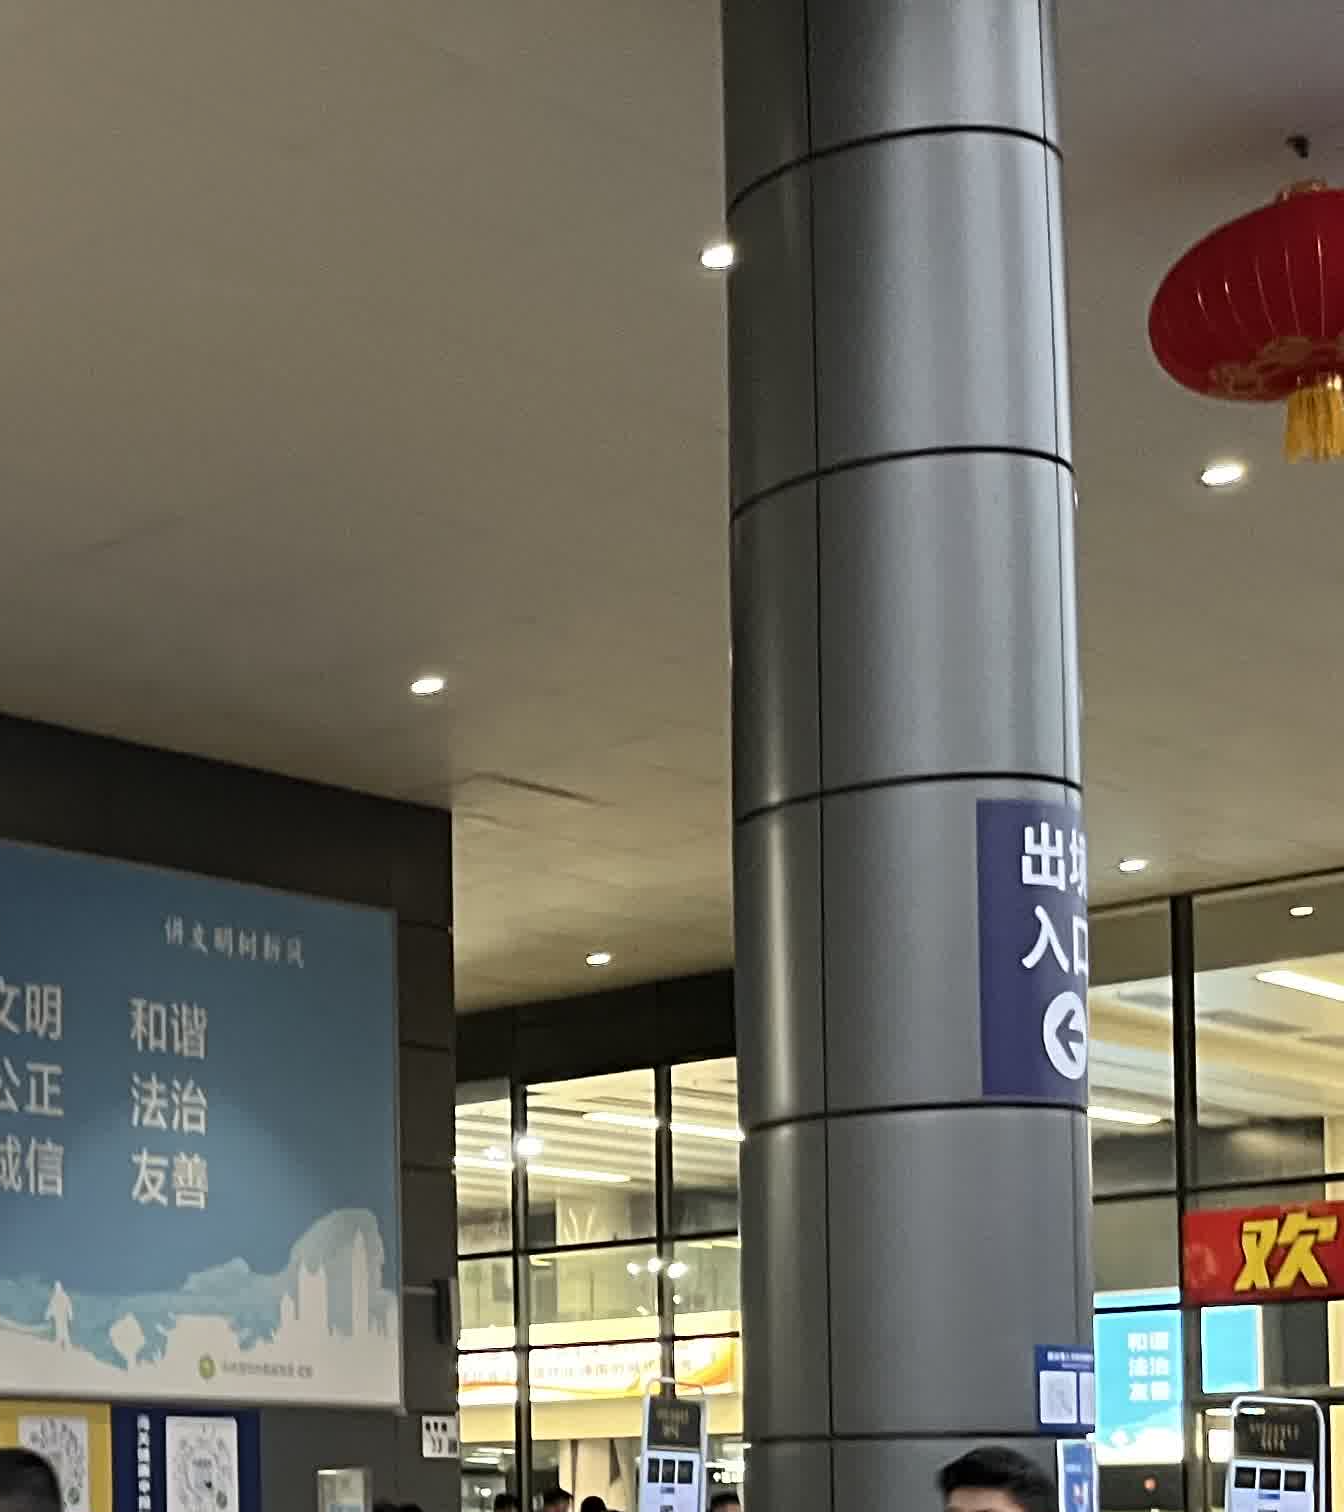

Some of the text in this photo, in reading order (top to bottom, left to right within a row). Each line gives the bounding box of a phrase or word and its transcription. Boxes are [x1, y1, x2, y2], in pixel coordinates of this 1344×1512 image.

[129, 998, 209, 1060] 和谐
[130, 1073, 209, 1136] 法治
[130, 1149, 209, 1210] 友善
[1234, 1211, 1339, 1290] 欢
